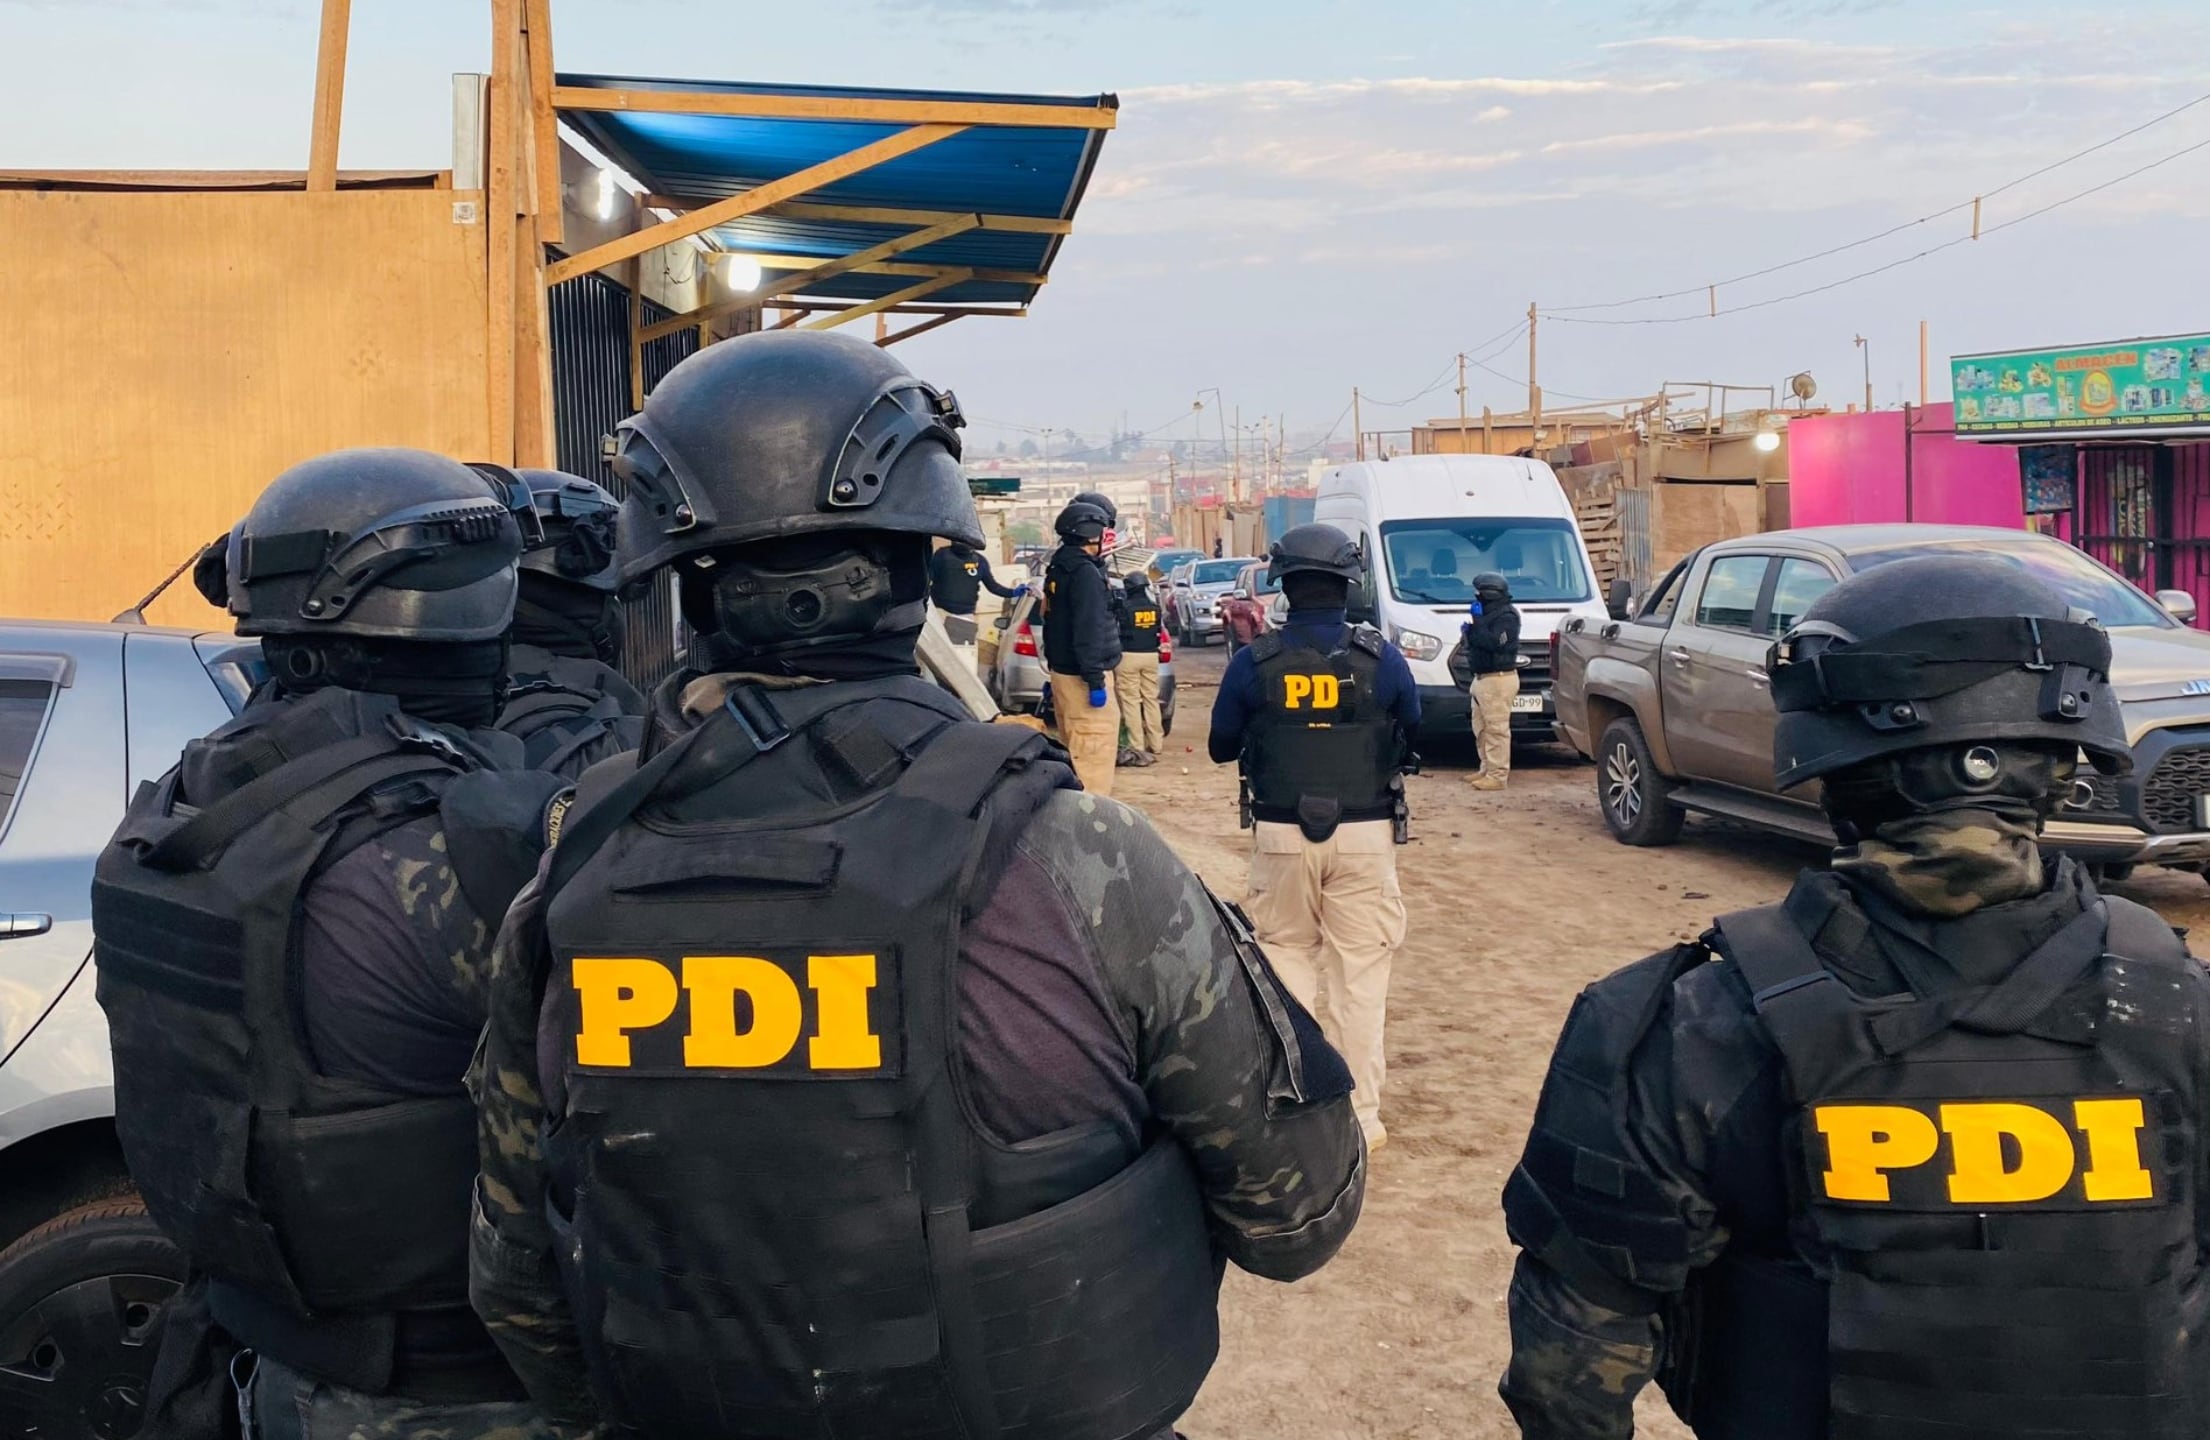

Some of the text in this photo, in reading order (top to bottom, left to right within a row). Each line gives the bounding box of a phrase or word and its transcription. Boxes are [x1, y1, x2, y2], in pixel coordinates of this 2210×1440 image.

[2055, 351, 2138, 371] ALMACEN
[1134, 611, 1156, 623] PDI
[1284, 674, 1339, 709] PD
[572, 954, 881, 1069] PDI
[1815, 1099, 2153, 1203] PDI
